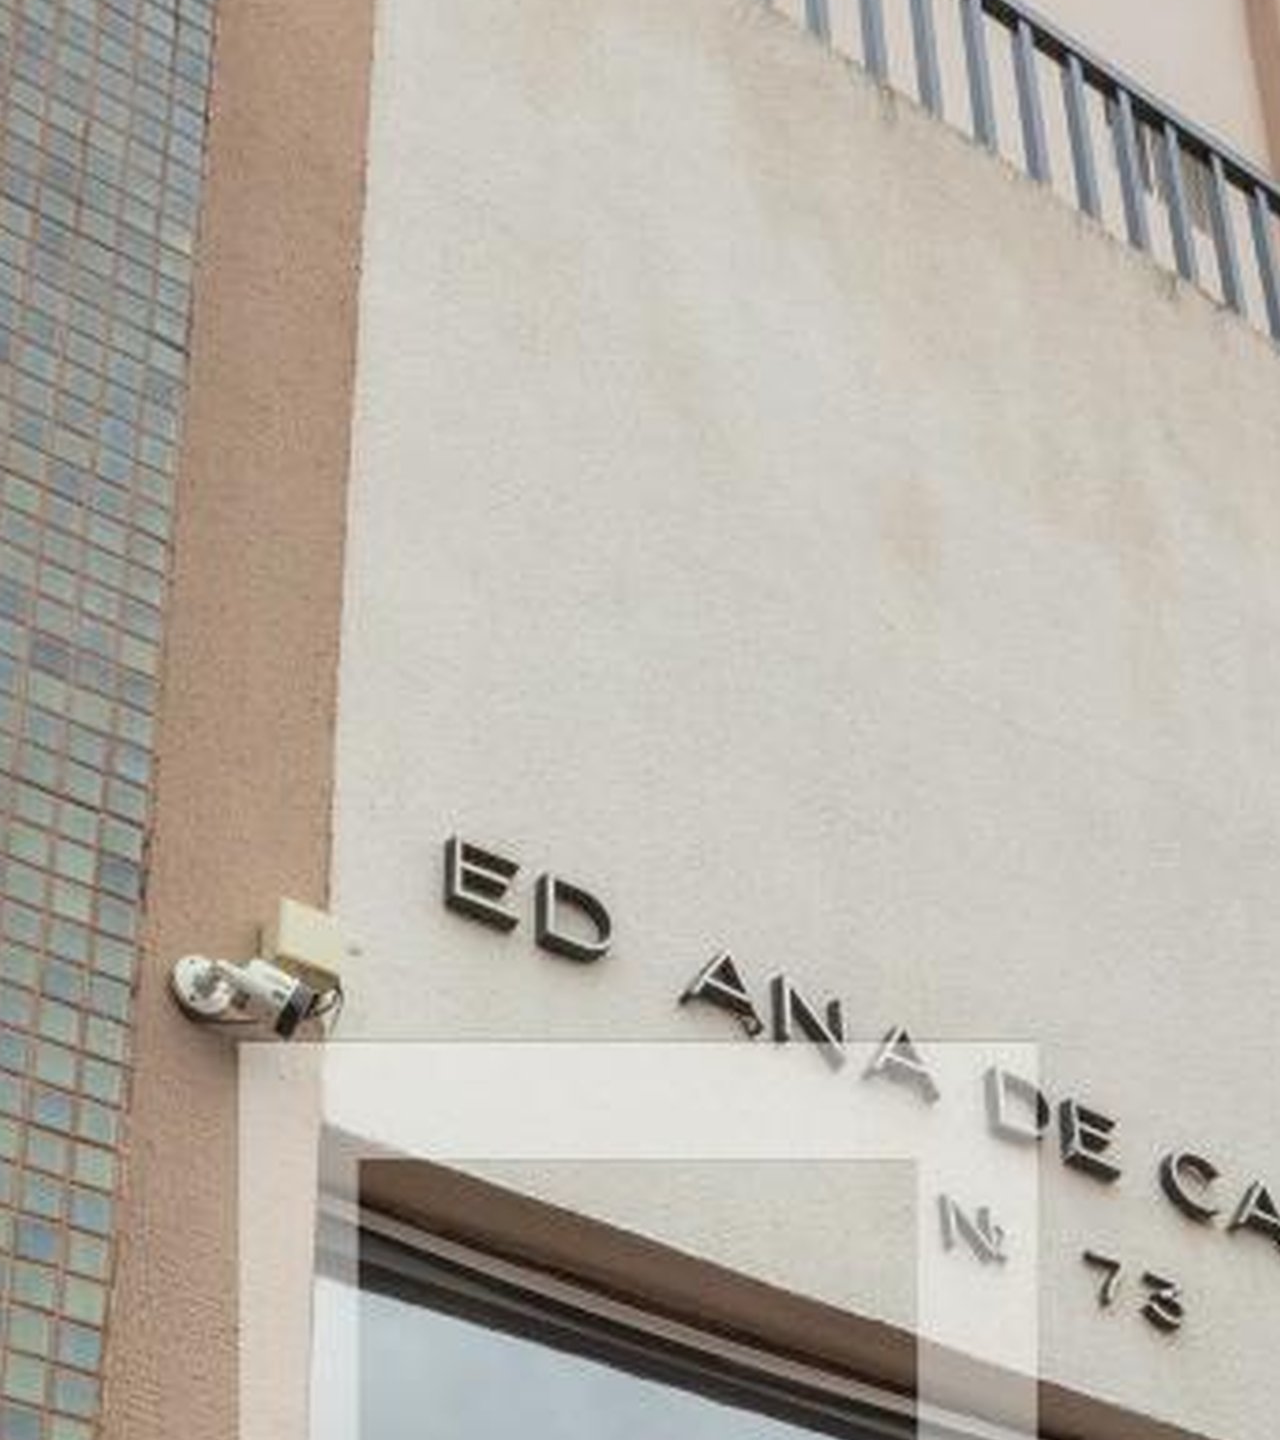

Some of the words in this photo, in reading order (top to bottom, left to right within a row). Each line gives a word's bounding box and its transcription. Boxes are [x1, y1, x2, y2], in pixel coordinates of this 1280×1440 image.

[443, 834, 612, 963] ED
[678, 952, 941, 1106] ANA
[983, 1065, 1123, 1182] DE
[1082, 1250, 1184, 1334] 73
